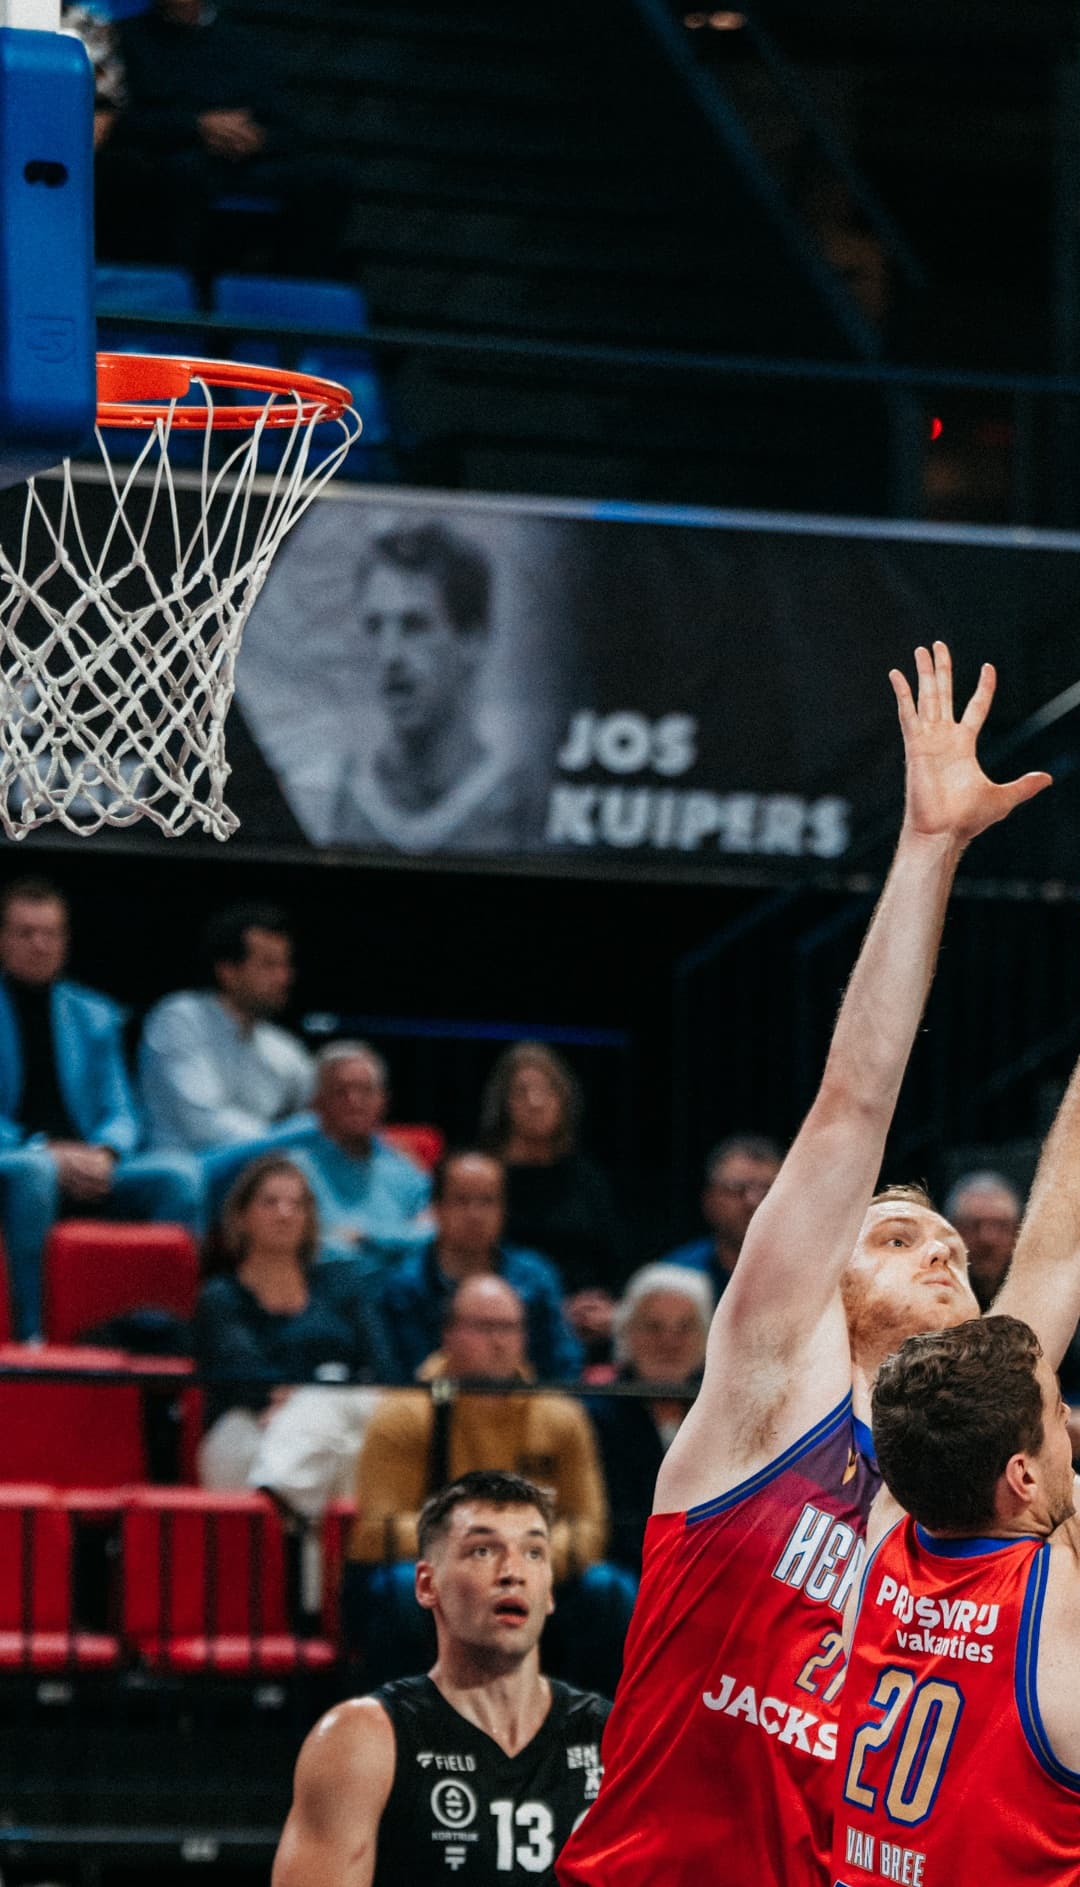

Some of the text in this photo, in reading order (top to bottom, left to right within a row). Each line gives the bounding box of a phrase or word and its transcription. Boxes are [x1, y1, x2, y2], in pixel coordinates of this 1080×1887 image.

[558, 710, 698, 776] JOS
[549, 787, 848, 857] KUIPERS
[896, 1629, 994, 1664] vakanties
[702, 1674, 838, 1760] JACKS
[843, 1665, 965, 1828] 20
[435, 1754, 477, 1772] FIELD
[489, 1800, 555, 1873] 13
[845, 1825, 926, 1887] VAN BREE
